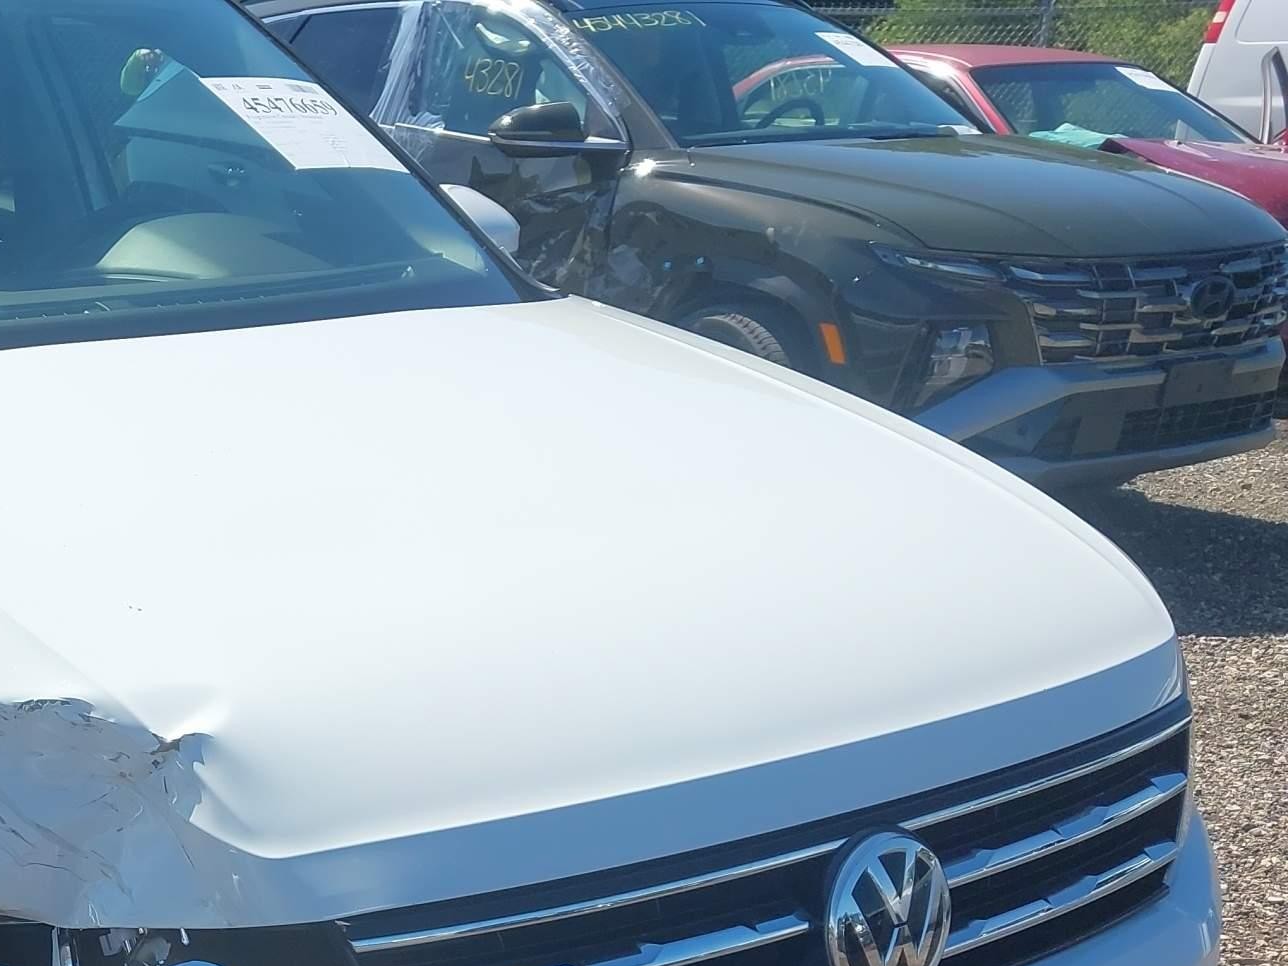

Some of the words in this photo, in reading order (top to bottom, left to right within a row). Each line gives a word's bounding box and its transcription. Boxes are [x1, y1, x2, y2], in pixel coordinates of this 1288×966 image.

[572, 10, 707, 32] 45443281
[464, 56, 525, 100] 43281
[241, 97, 338, 116] 45476659
